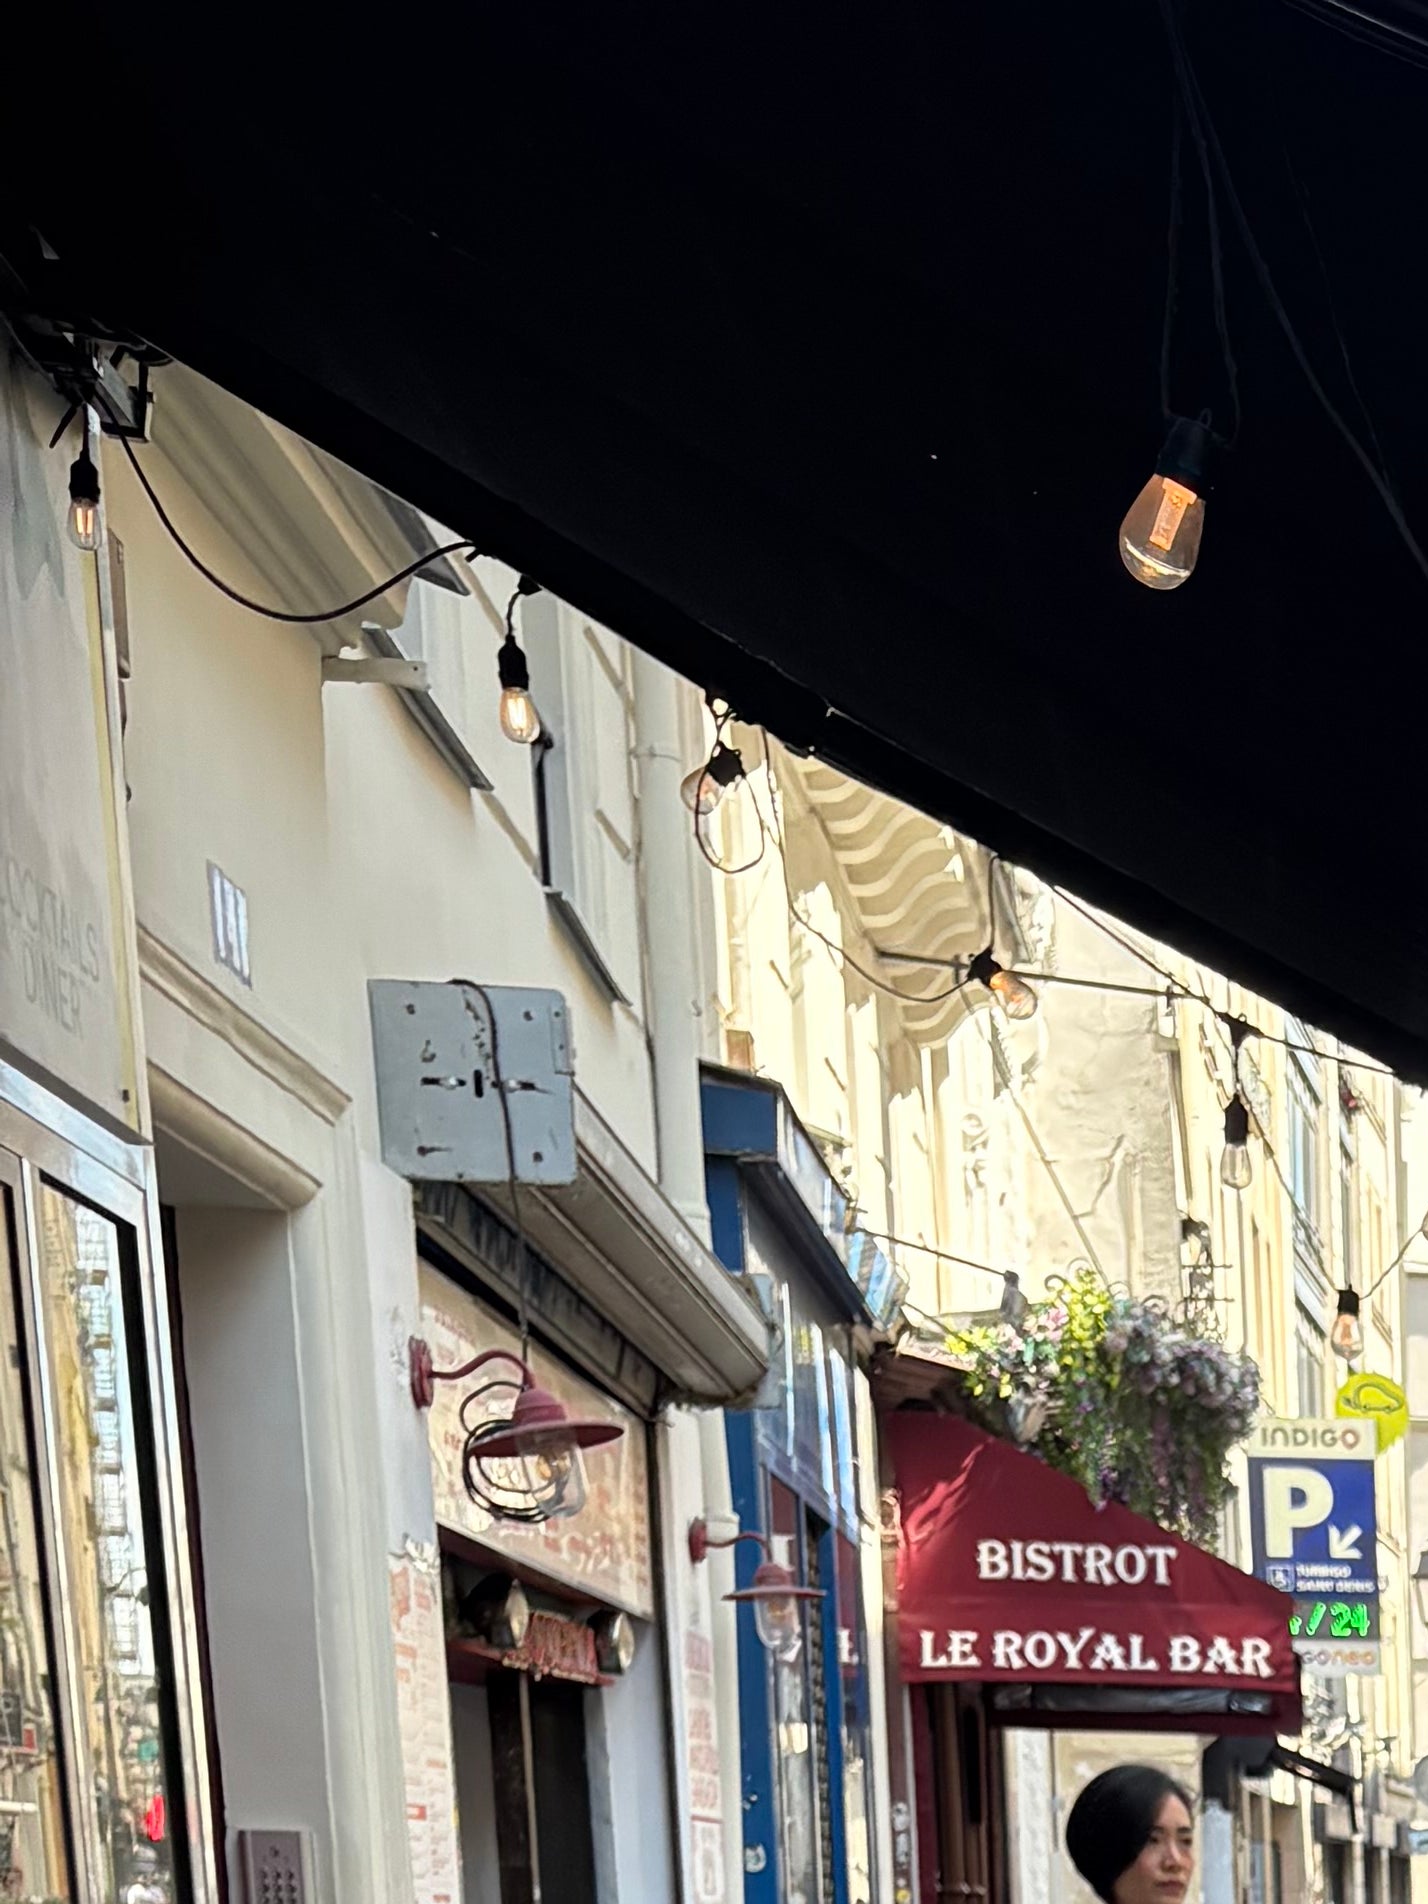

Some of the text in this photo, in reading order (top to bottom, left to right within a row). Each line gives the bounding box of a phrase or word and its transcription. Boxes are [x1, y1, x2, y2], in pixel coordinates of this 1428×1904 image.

[976, 1539, 1178, 1586] BISTROT
[919, 1627, 1274, 1679] LE ROYAL BAR
